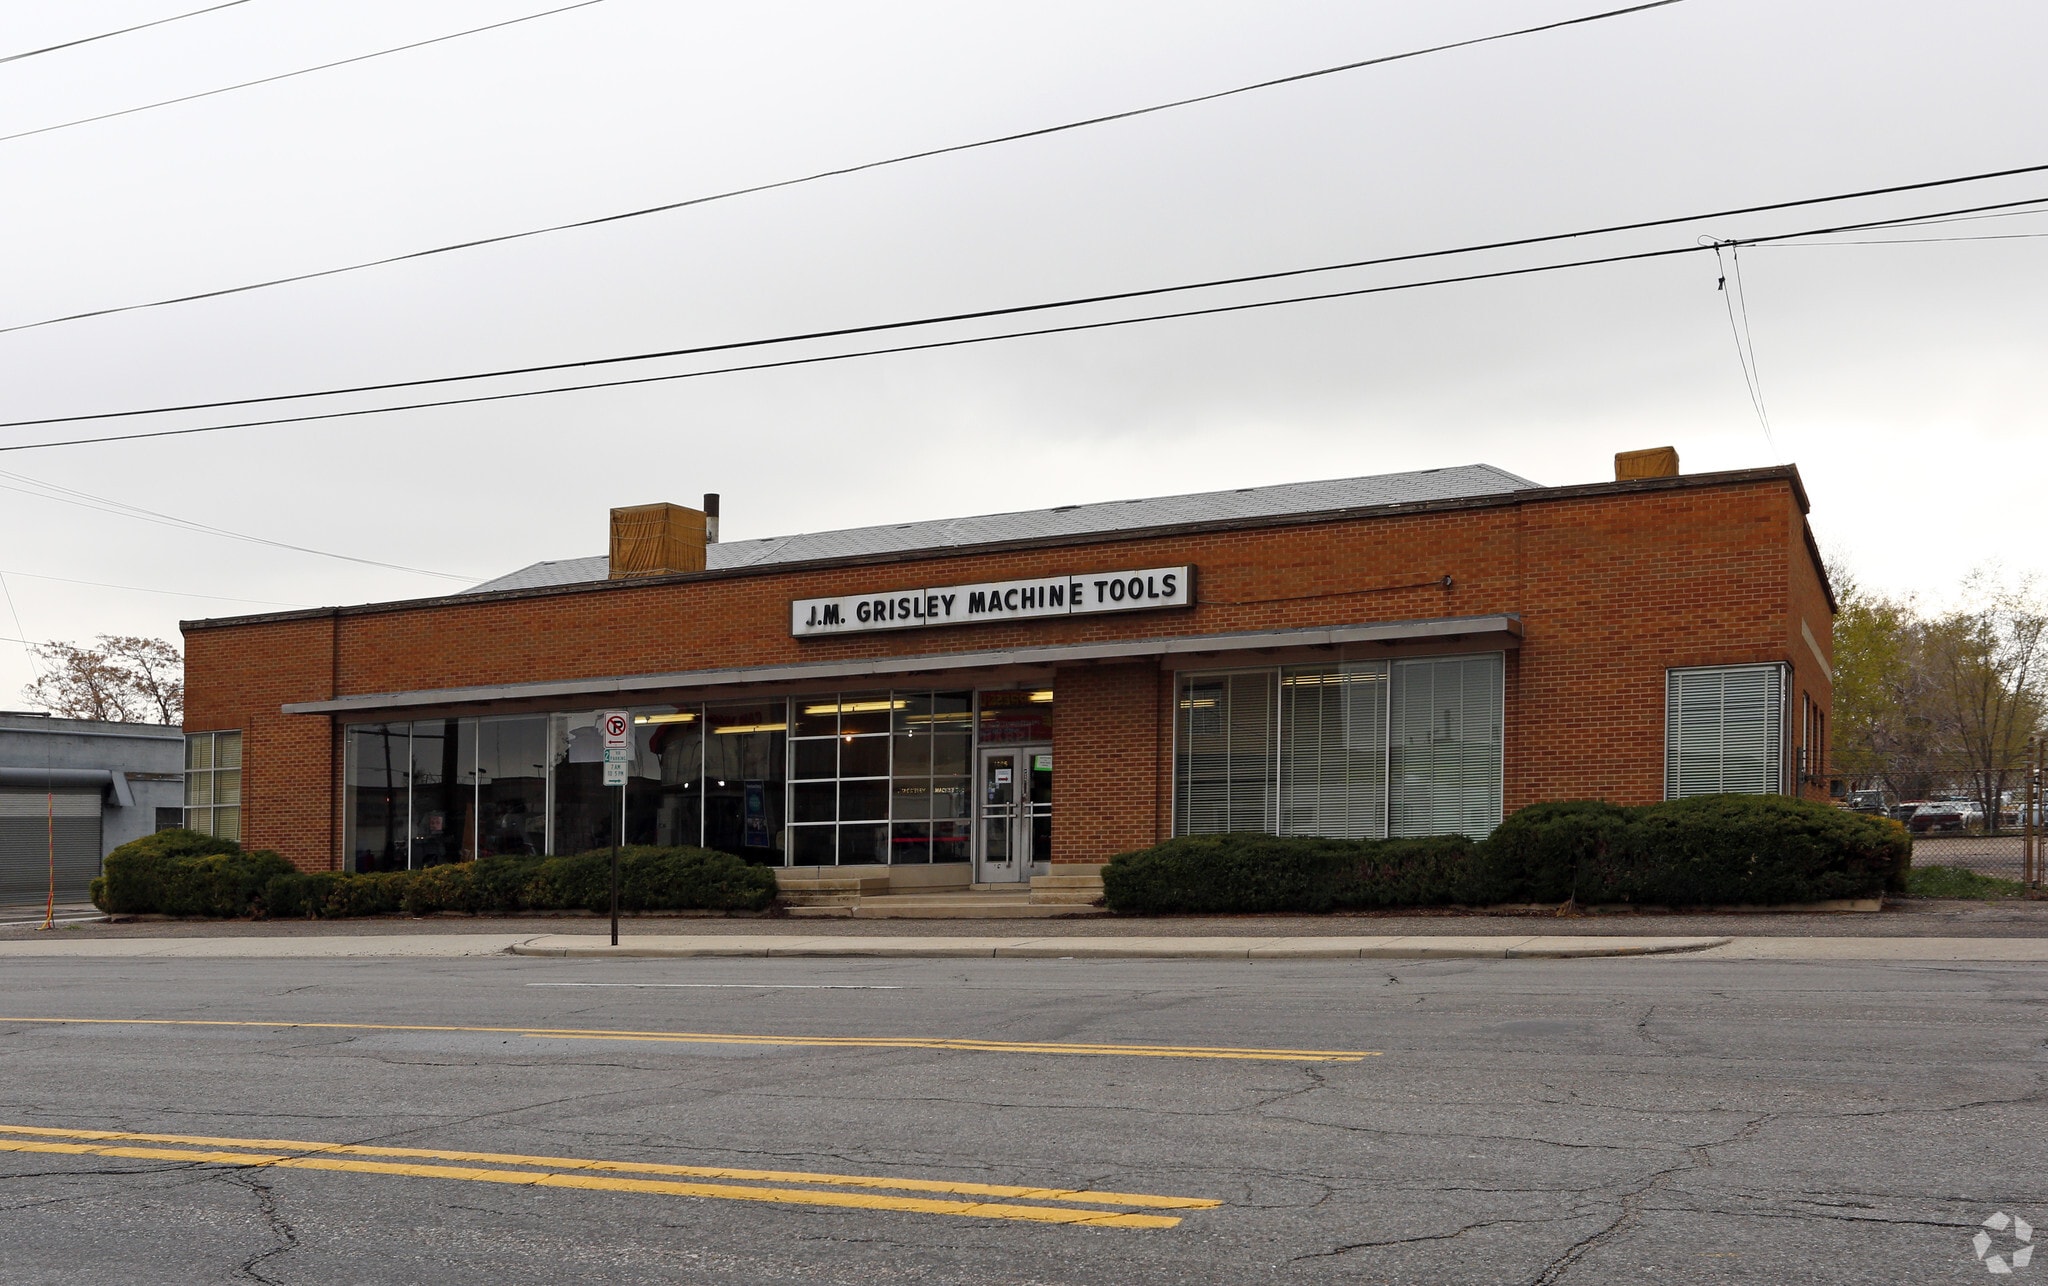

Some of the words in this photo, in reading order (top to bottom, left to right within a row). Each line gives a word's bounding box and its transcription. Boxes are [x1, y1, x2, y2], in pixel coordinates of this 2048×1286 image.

[806, 604, 846, 627] J.M.
[857, 594, 956, 623] GRISLEY
[968, 583, 1083, 614] MACHINE
[1093, 574, 1177, 603] TOOLS
